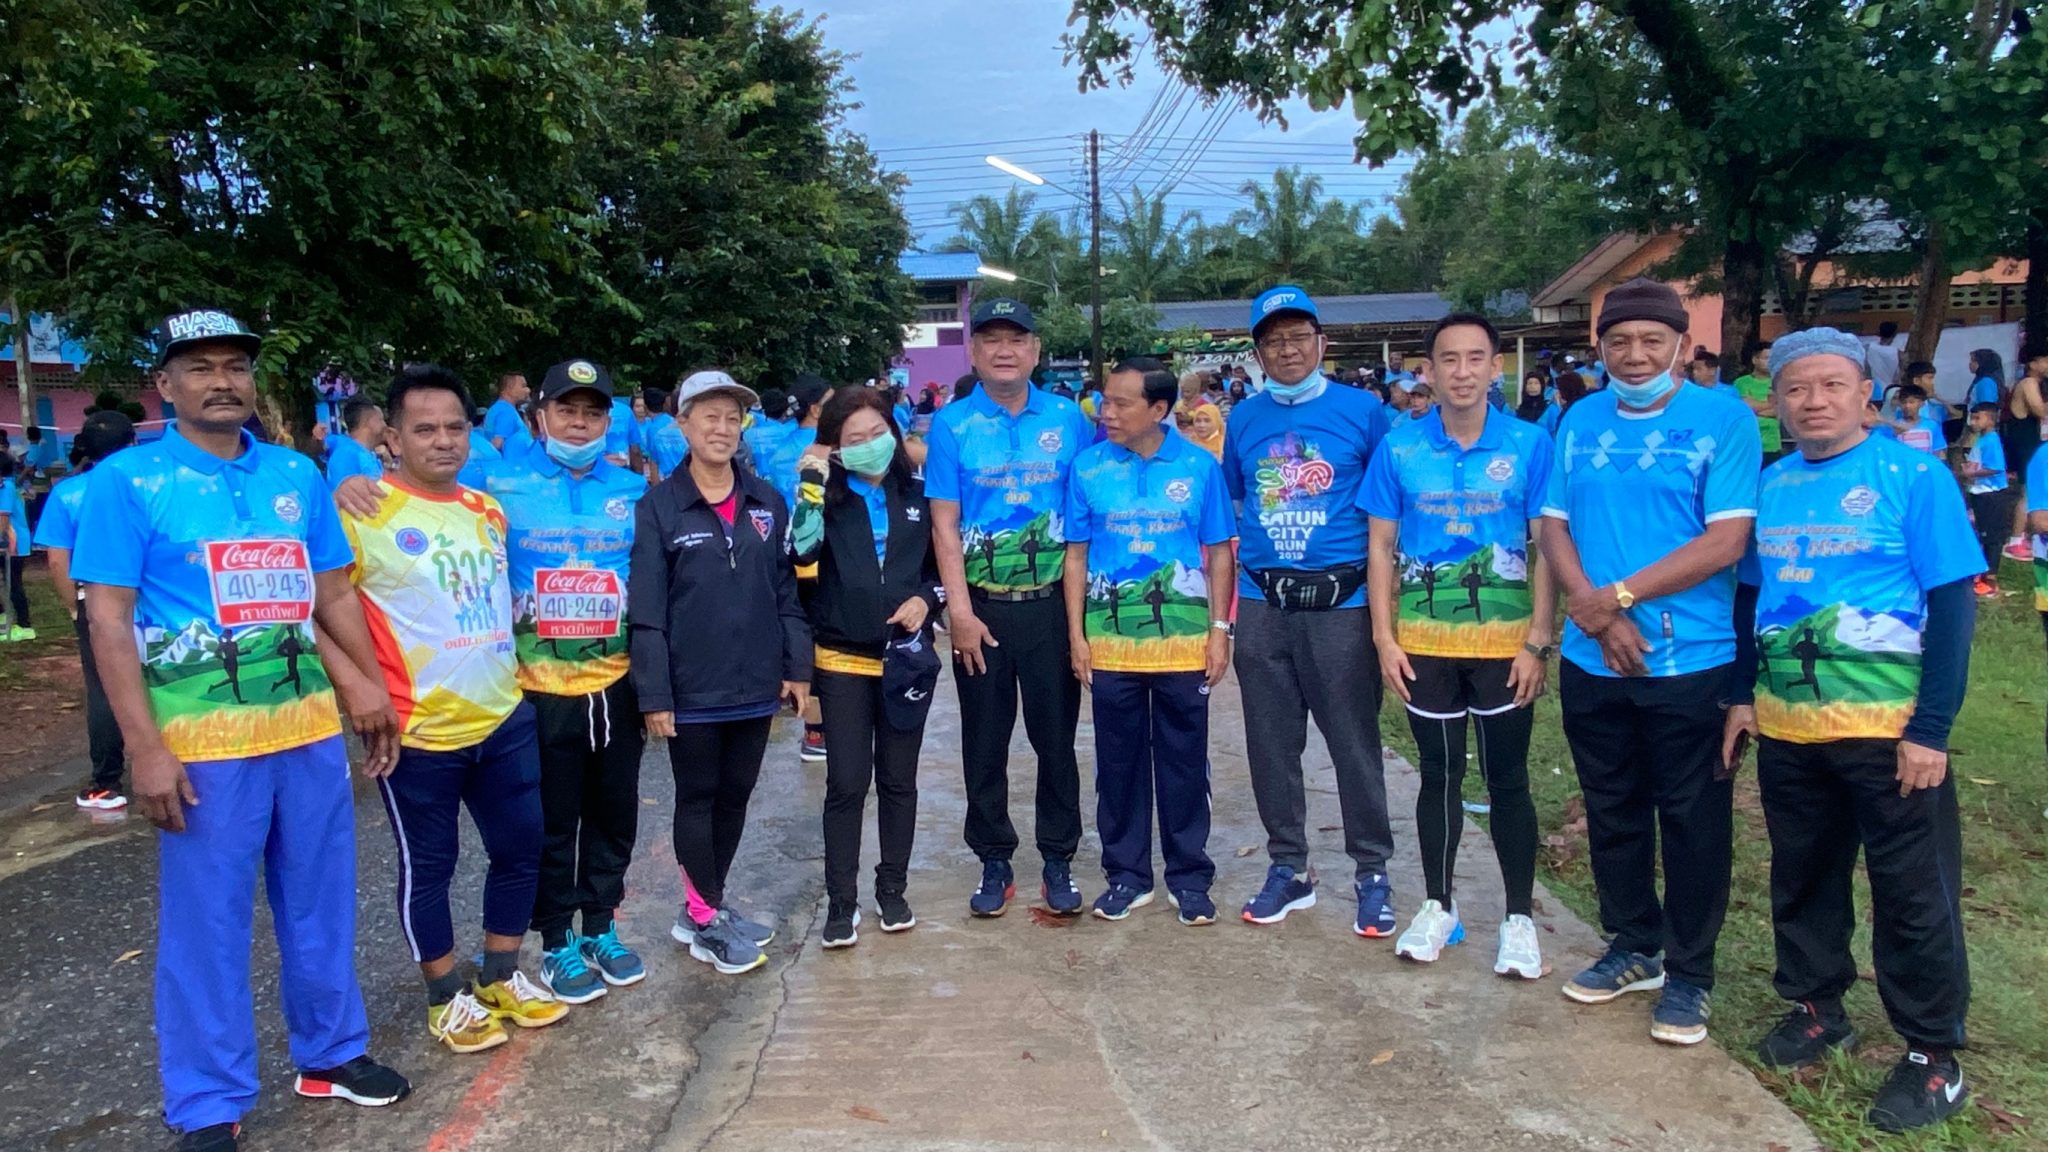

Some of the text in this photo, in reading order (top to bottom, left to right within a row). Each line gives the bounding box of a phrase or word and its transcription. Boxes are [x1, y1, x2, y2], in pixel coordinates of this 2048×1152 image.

[169, 311, 240, 338] HASH
[1202, 353, 1232, 364] Ban
[1259, 511, 1327, 525] SATUN
[1267, 527, 1314, 540] CITY
[1274, 540, 1306, 551] RUN
[221, 542, 297, 569] Coca-Cola
[1278, 552, 1304, 560] 2019
[228, 573, 307, 600] 40-245
[543, 571, 612, 593] Coca-Cola
[544, 597, 615, 619] 40-244
